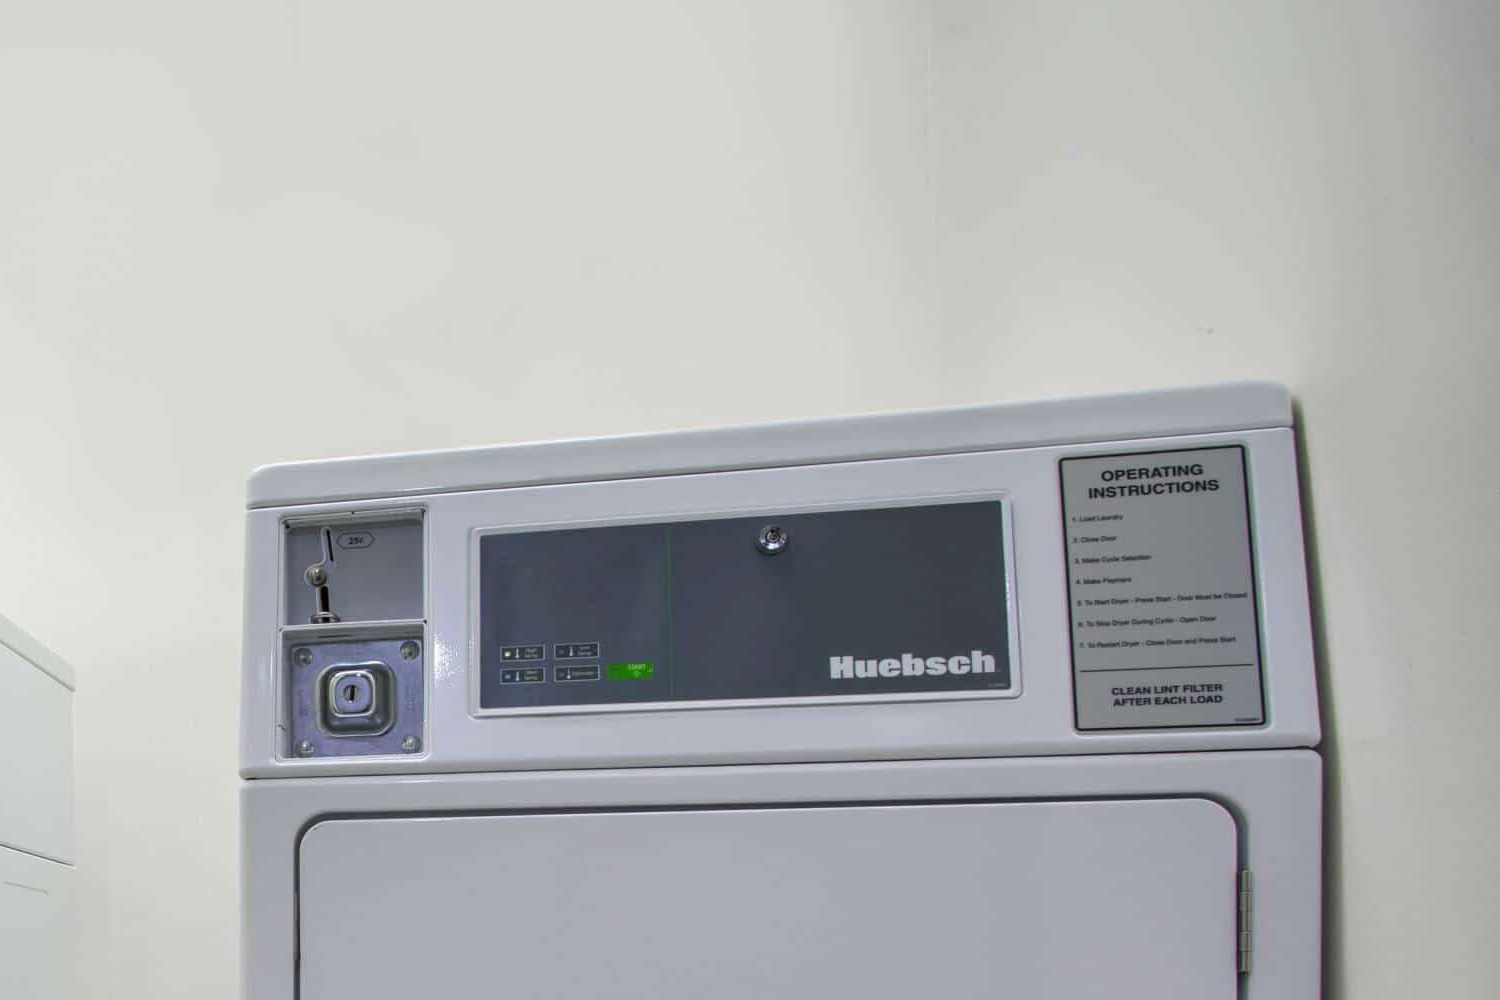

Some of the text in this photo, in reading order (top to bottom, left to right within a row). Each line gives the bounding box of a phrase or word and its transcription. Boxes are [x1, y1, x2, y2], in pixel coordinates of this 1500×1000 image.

[1101, 464, 1204, 481] OPERATING
[1089, 479, 1220, 499] INSTRUCTIONS
[1097, 514, 1123, 522] Laundry
[1102, 576, 1132, 584] Payment
[1111, 598, 1128, 606] Dryer
[1112, 619, 1130, 627] Dryer
[1131, 618, 1154, 626] During
[1155, 617, 1173, 625] Cycle
[1179, 616, 1198, 624] Open
[1121, 640, 1140, 648] Dryer
[829, 650, 996, 679] Huebsch
[1111, 683, 1223, 696] CLEAN LINT FILTER
[1113, 694, 1223, 707] AFTER EACH LOAD
